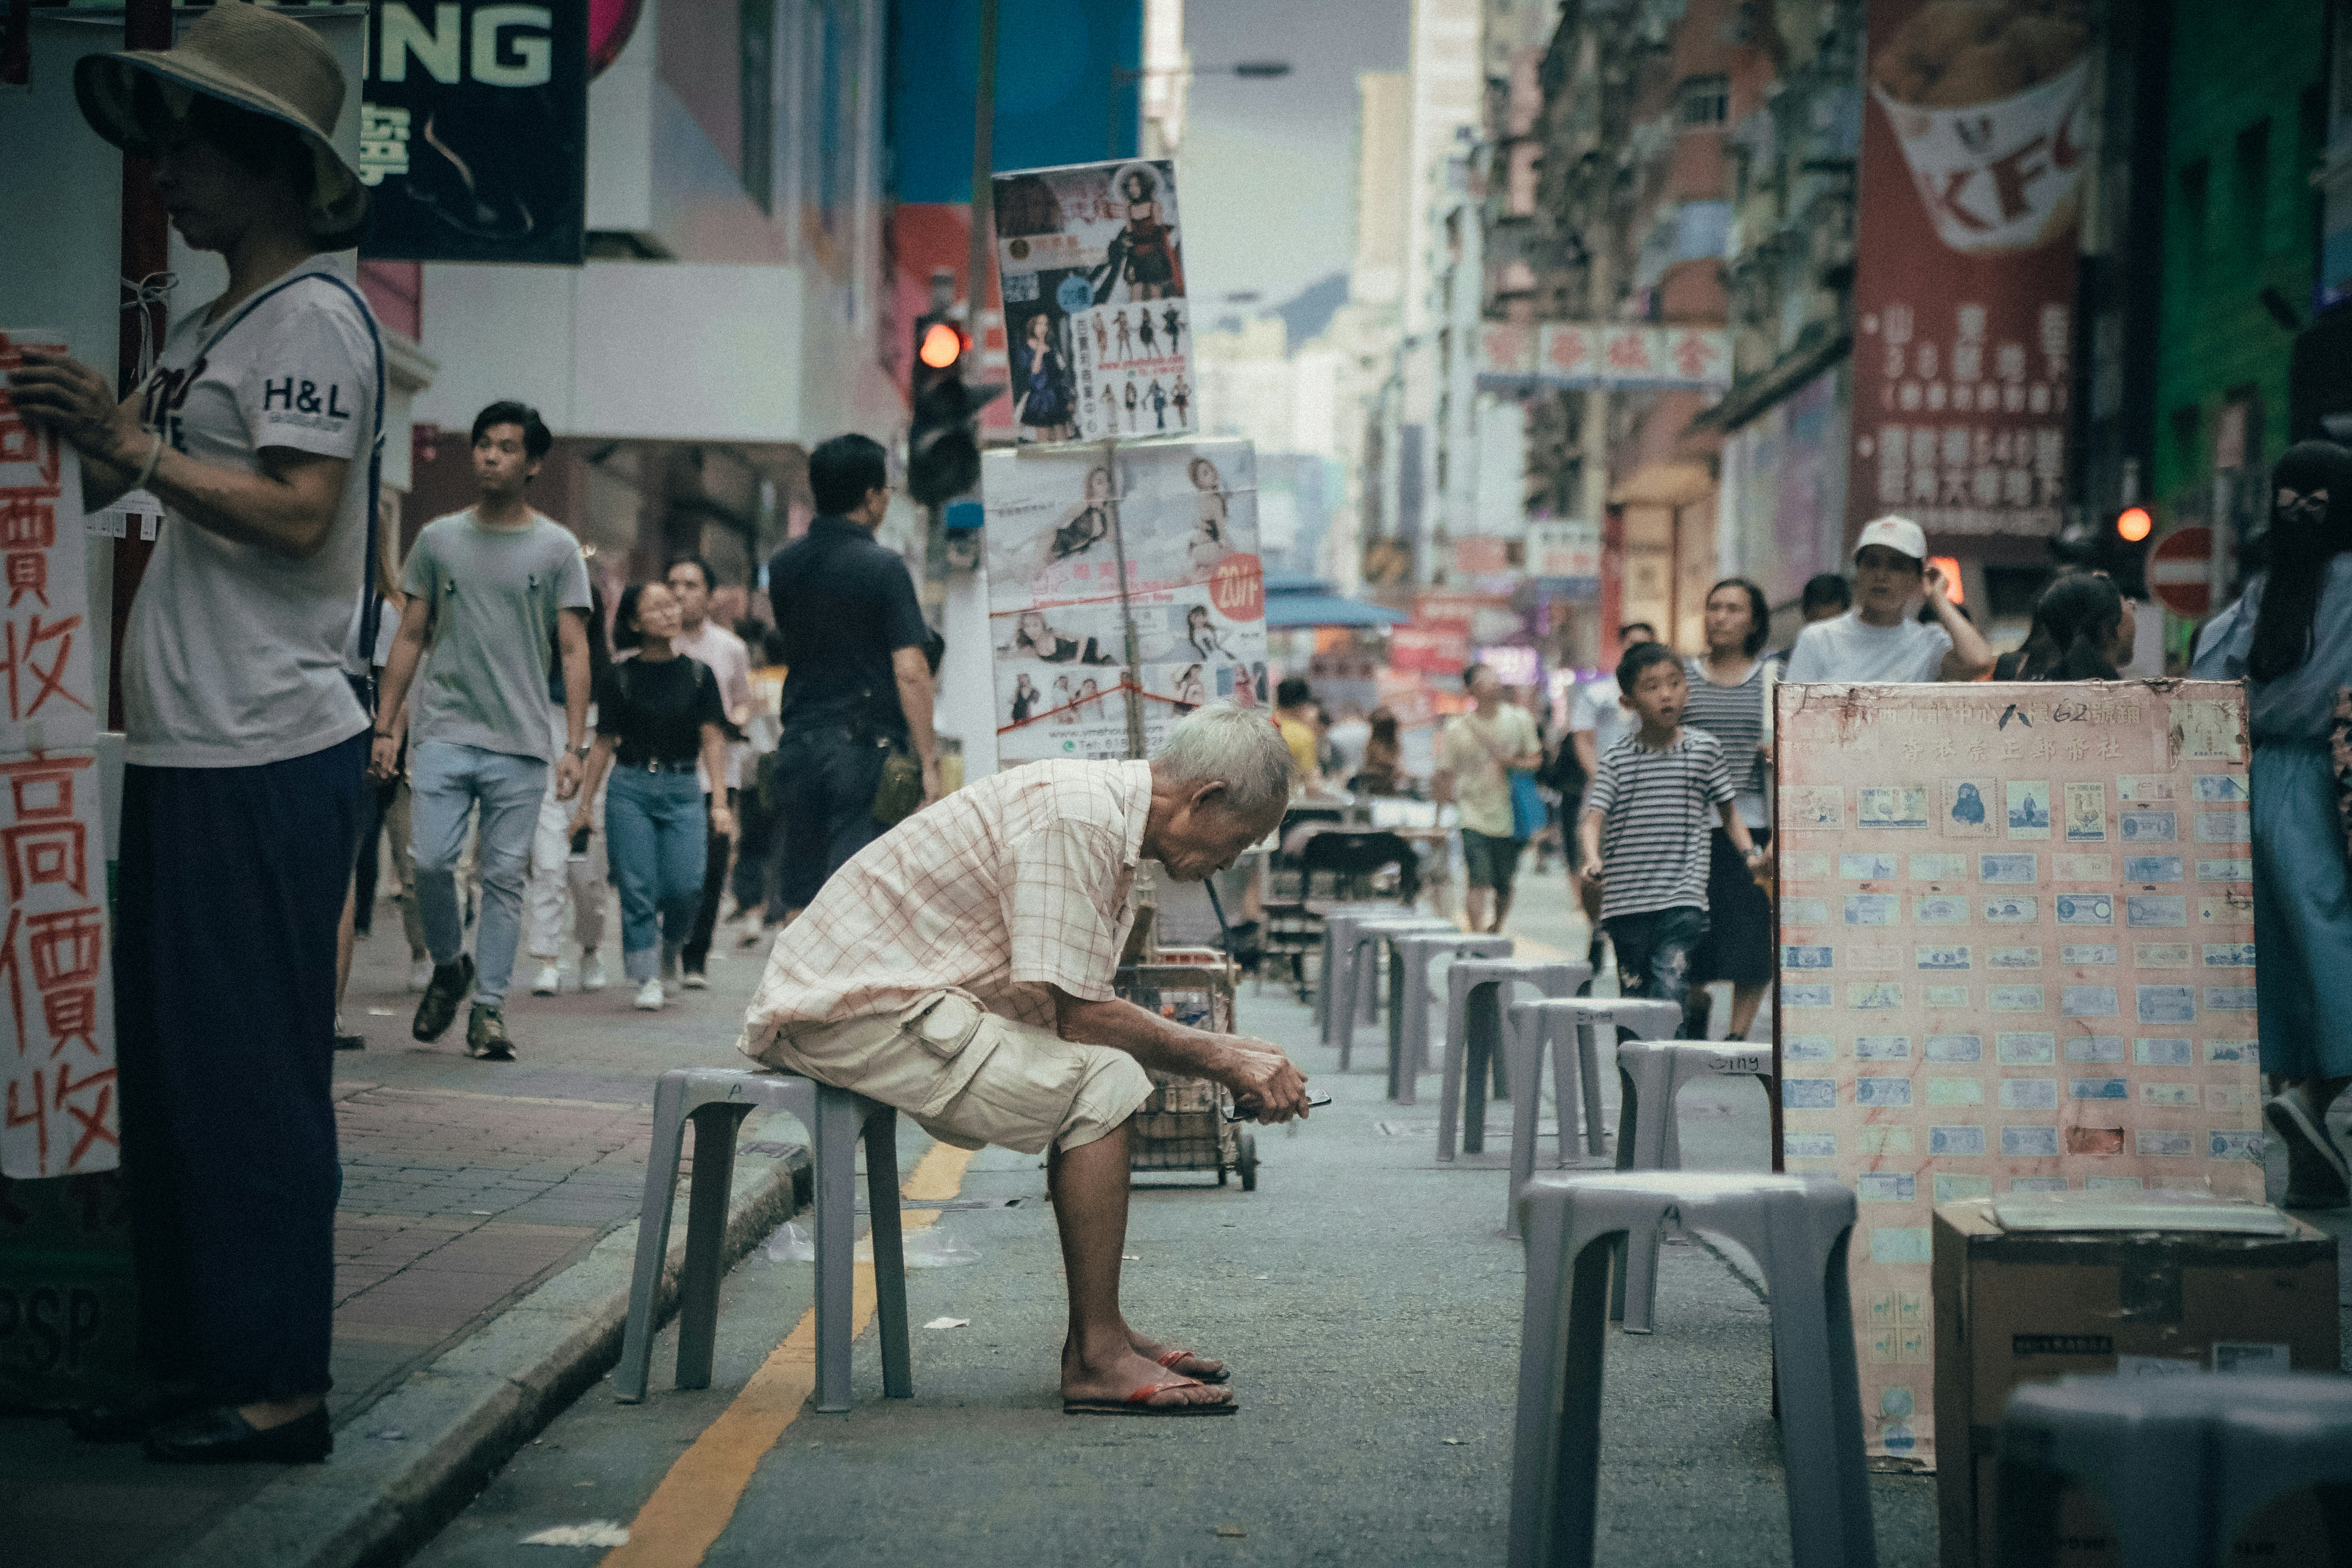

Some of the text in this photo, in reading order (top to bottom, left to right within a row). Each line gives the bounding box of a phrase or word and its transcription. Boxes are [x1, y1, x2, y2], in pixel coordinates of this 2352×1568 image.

[263, 376, 351, 420] H&L
[0, 748, 119, 1177] 高價收
